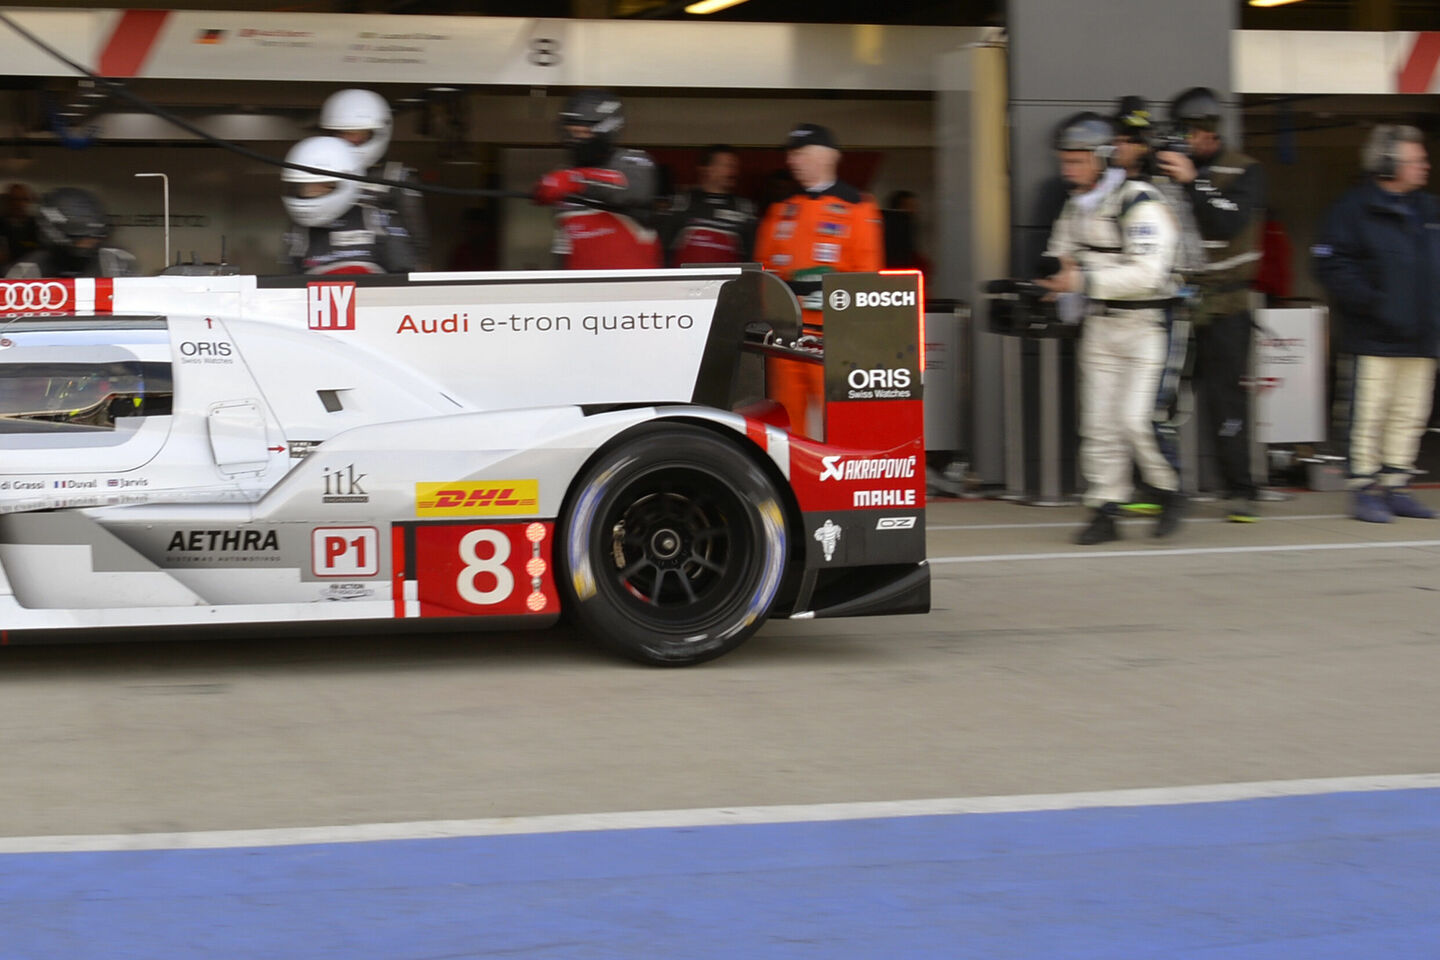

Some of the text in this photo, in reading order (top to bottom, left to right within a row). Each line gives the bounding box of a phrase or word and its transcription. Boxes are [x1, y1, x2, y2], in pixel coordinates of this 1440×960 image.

[528, 38, 561, 68] 8
[308, 285, 355, 328] HY
[855, 291, 916, 308] BOSCH
[396, 312, 694, 335] Audi e-tron quattro
[180, 341, 232, 357] ORIS
[847, 368, 912, 389] ORIS
[848, 389, 912, 399] Swiss Watches
[0, 477, 148, 490] di Grassi Duval Jarvis
[321, 463, 369, 496] itk
[434, 488, 521, 508] DHL
[853, 489, 916, 507] MAHLE
[879, 518, 913, 528] OZ
[167, 530, 280, 551] AETHRA
[324, 535, 367, 568] P1
[456, 528, 515, 605] 8
